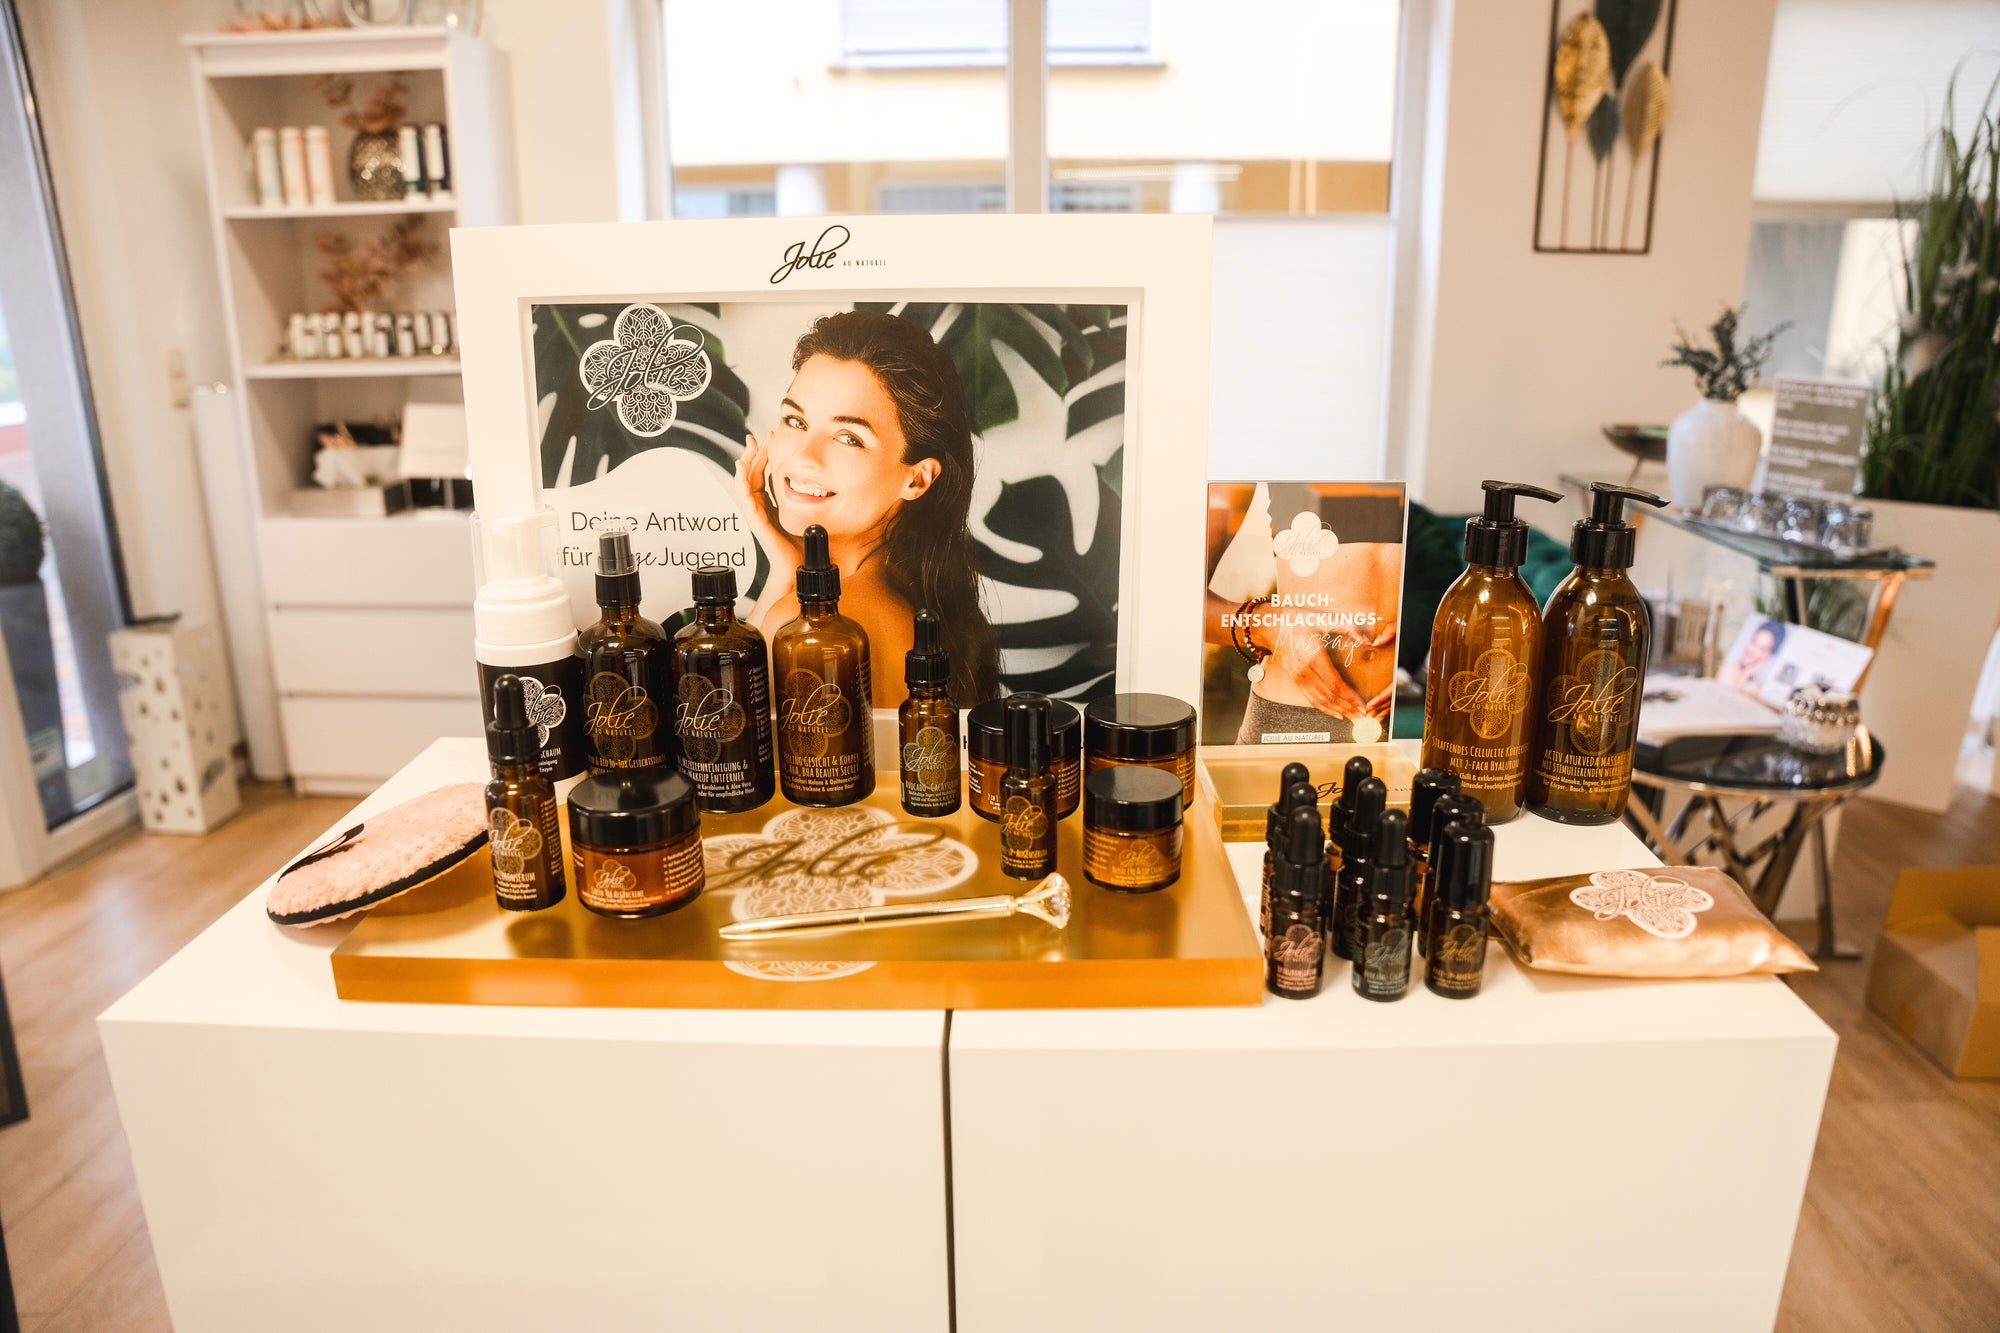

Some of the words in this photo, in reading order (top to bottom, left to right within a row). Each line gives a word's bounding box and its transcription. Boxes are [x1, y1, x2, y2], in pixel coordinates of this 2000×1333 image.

[770, 225, 850, 284] Jolie
[587, 325, 705, 411] Jolie
[645, 511, 740, 532] Antwort
[563, 546, 593, 567] für
[658, 547, 746, 572] Jugend
[1270, 593, 1336, 608] BAUCH-
[1220, 611, 1384, 628] ENTSCHLACKUNGS-
[1271, 627, 1365, 668] Massage
[1450, 662, 1529, 712] Jolie
[1547, 666, 1638, 723] Jolie
[584, 685, 648, 737] Jolie
[675, 687, 734, 736] Jolie
[781, 683, 841, 731] Jolie
[1263, 735, 1281, 743] JOLIE
[1283, 735, 1294, 743] AU
[1431, 735, 1468, 756] STRAFFENDES
[1464, 759, 1488, 771] 2-FACH
[1543, 748, 1563, 763] AKTIV
[1564, 753, 1600, 768] AYURVEDA
[711, 771, 745, 783] ENTFERNER
[1000, 805, 1043, 833] Jolie
